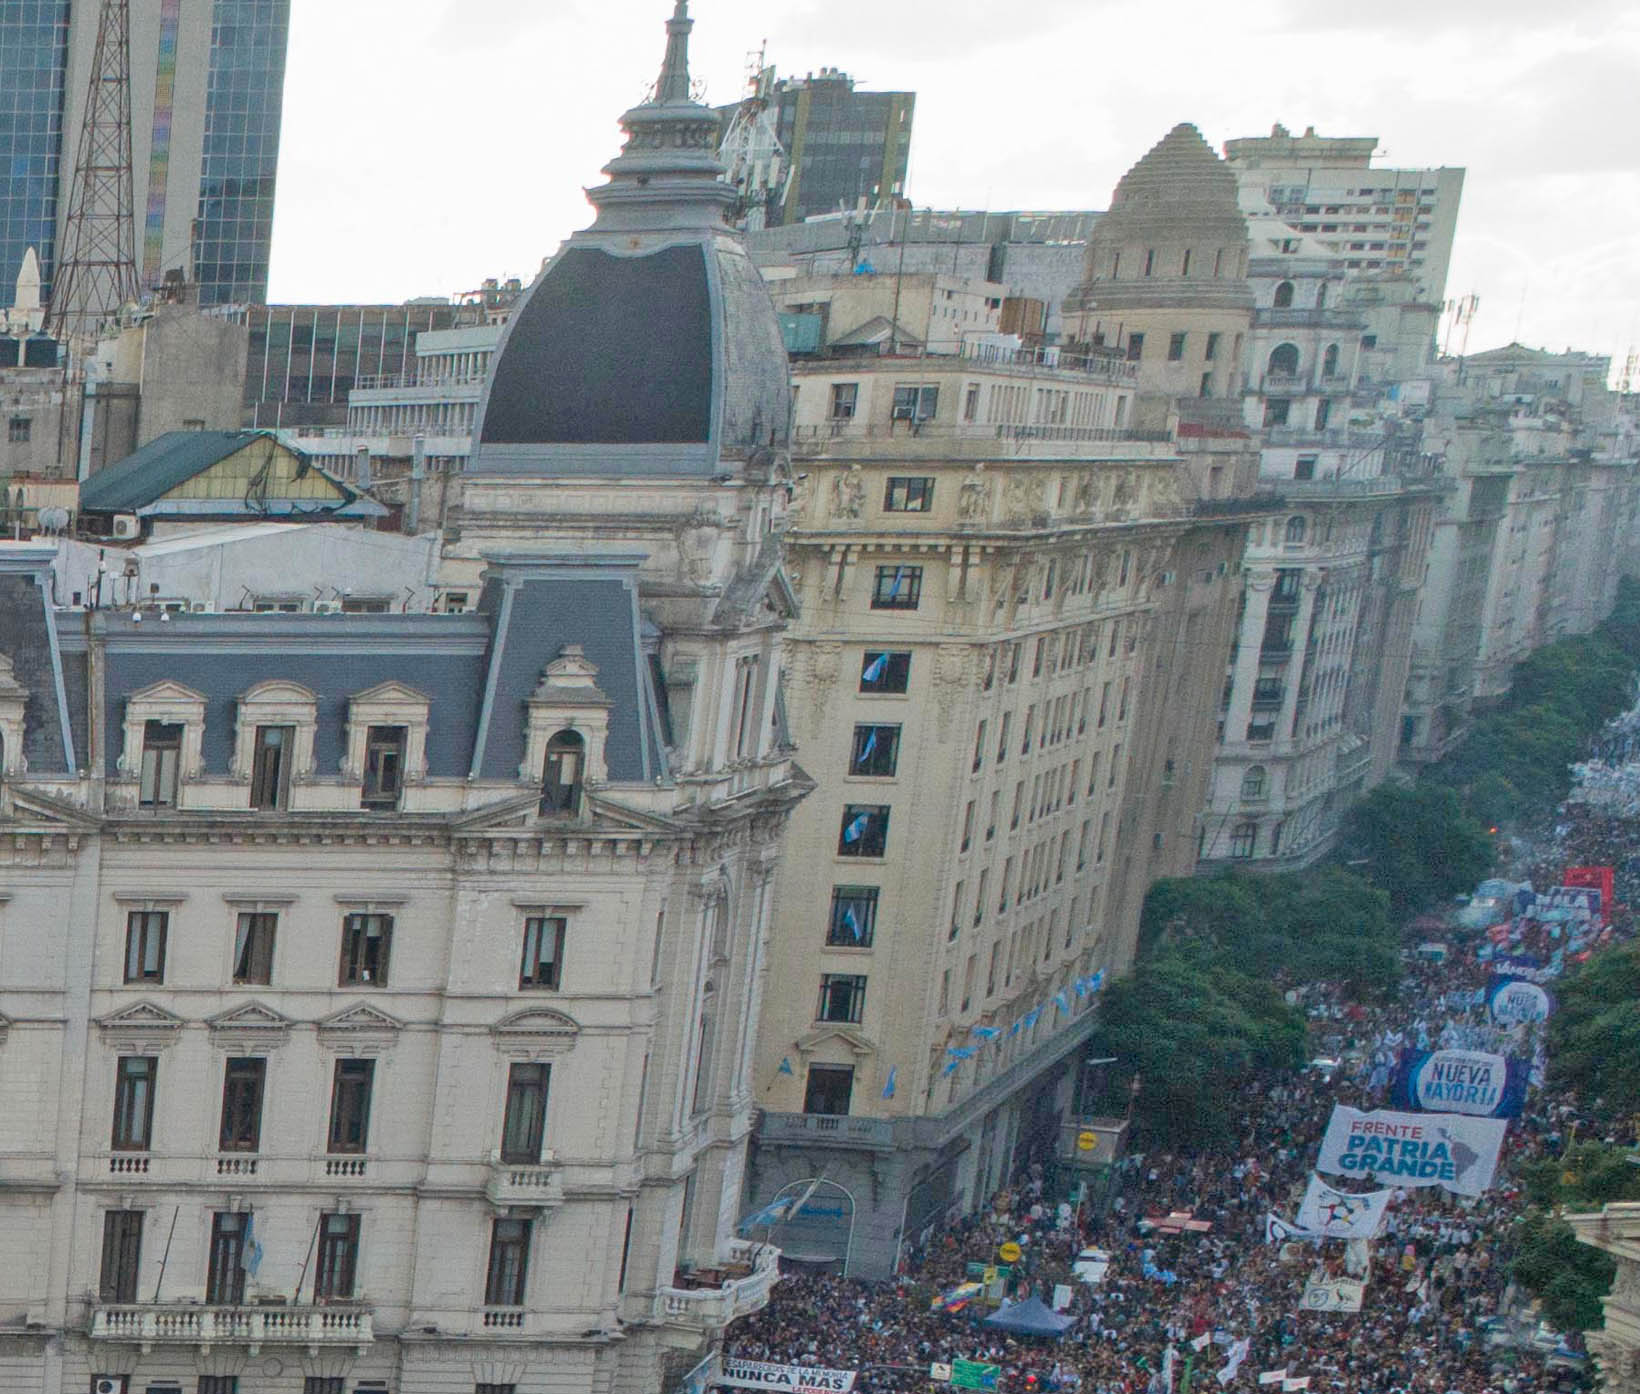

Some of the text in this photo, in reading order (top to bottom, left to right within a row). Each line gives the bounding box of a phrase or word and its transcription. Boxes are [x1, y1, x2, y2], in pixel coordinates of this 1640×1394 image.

[1432, 1062, 1491, 1086] NUEVA
[1351, 1120, 1423, 1140] FRENTE
[1348, 1134, 1449, 1161] PATRIA
[1338, 1153, 1456, 1181] GRANDE
[723, 1368, 792, 1385] NUNCA
